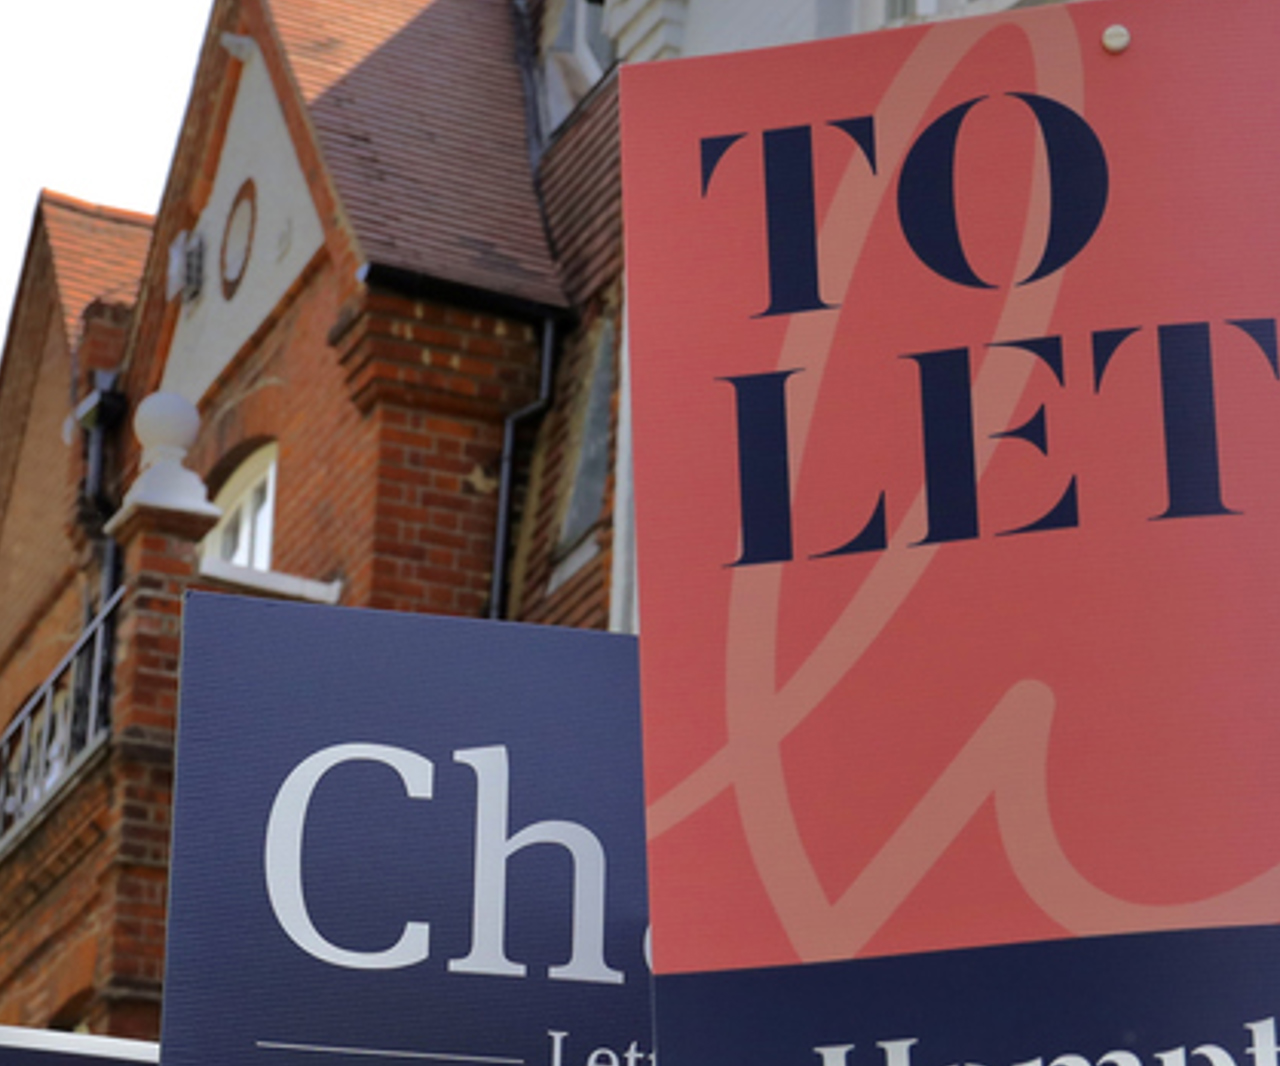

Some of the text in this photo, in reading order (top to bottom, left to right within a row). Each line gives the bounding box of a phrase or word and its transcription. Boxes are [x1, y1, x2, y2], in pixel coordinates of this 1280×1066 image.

[700, 92, 1110, 319] TO
[714, 318, 1280, 569] LET
[265, 742, 653, 984] Ch
